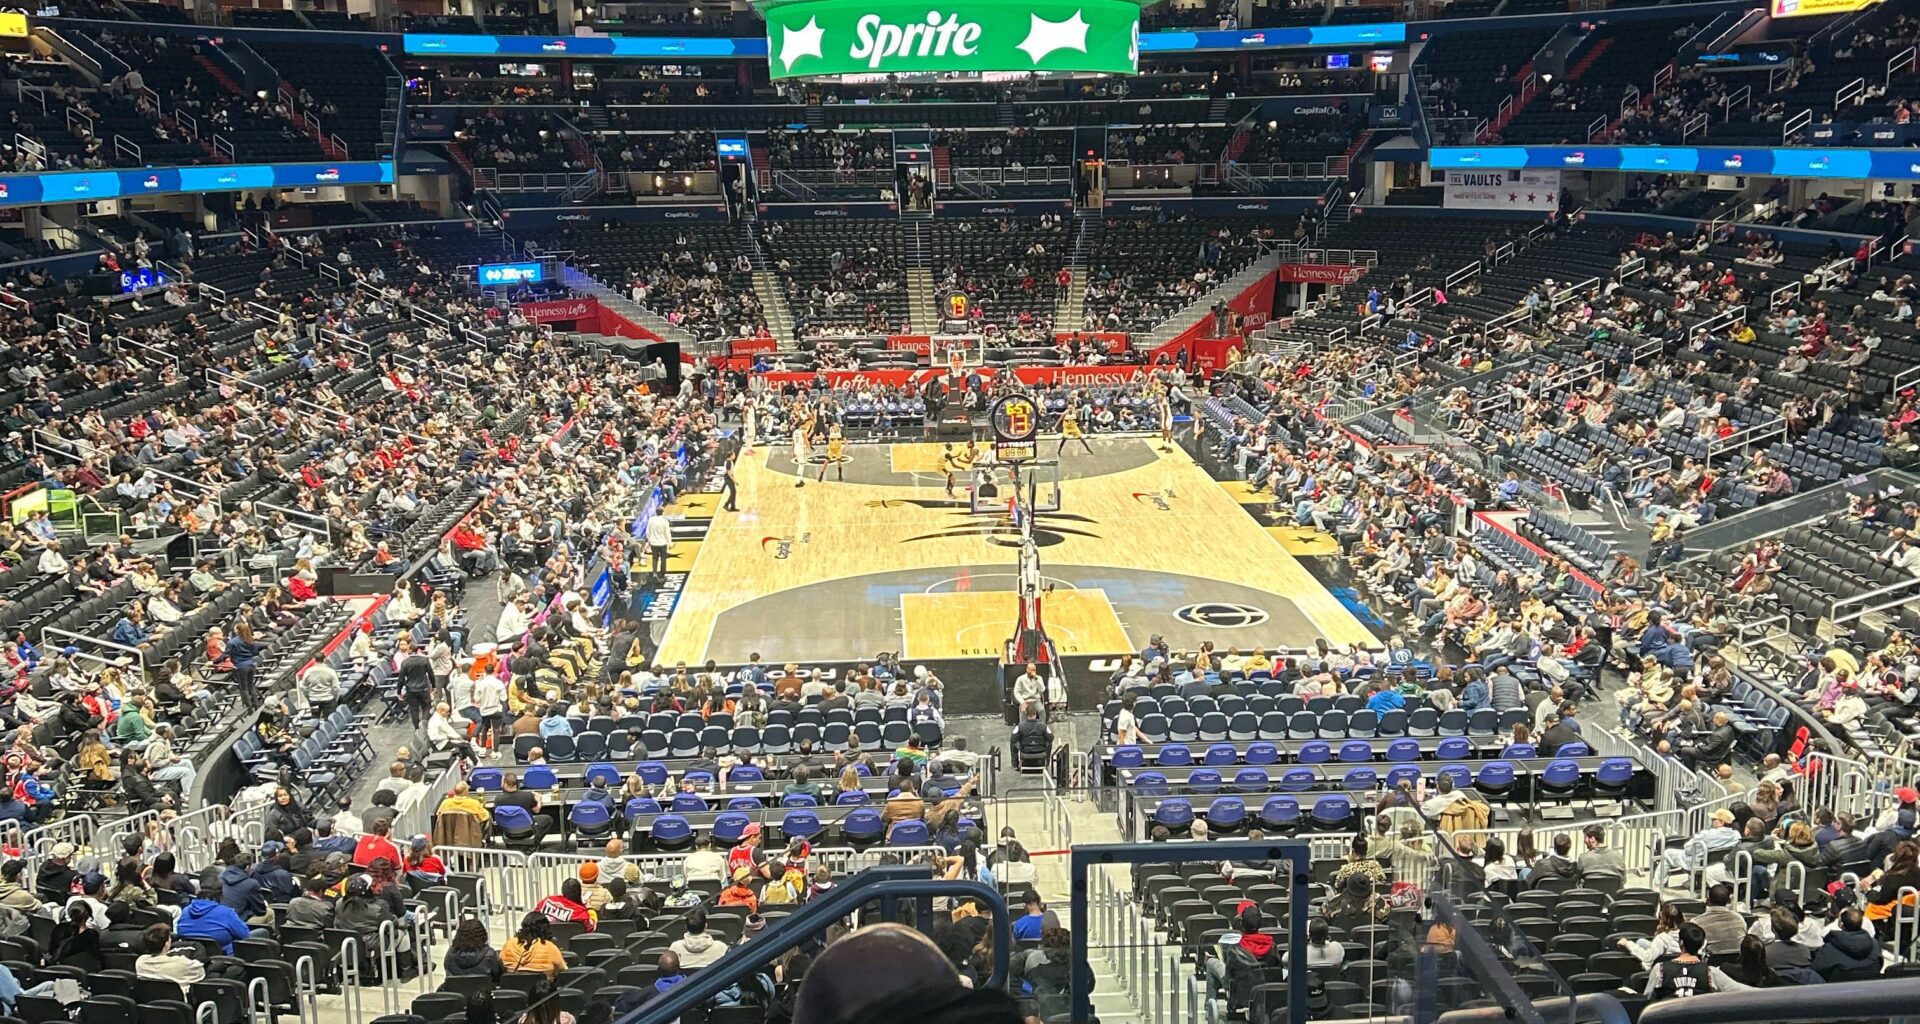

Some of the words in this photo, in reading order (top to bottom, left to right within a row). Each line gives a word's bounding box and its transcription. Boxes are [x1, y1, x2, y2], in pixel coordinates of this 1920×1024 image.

[849, 10, 982, 68] Sprite
[1463, 174, 1502, 186] VAULTS
[1293, 267, 1337, 280] Hennessy
[529, 307, 567, 319] Hennessy
[567, 304, 587, 316] Lofts
[1052, 370, 1128, 386] Hennessy
[641, 592, 678, 621] Hidden
[544, 902, 571, 922] TEAM
